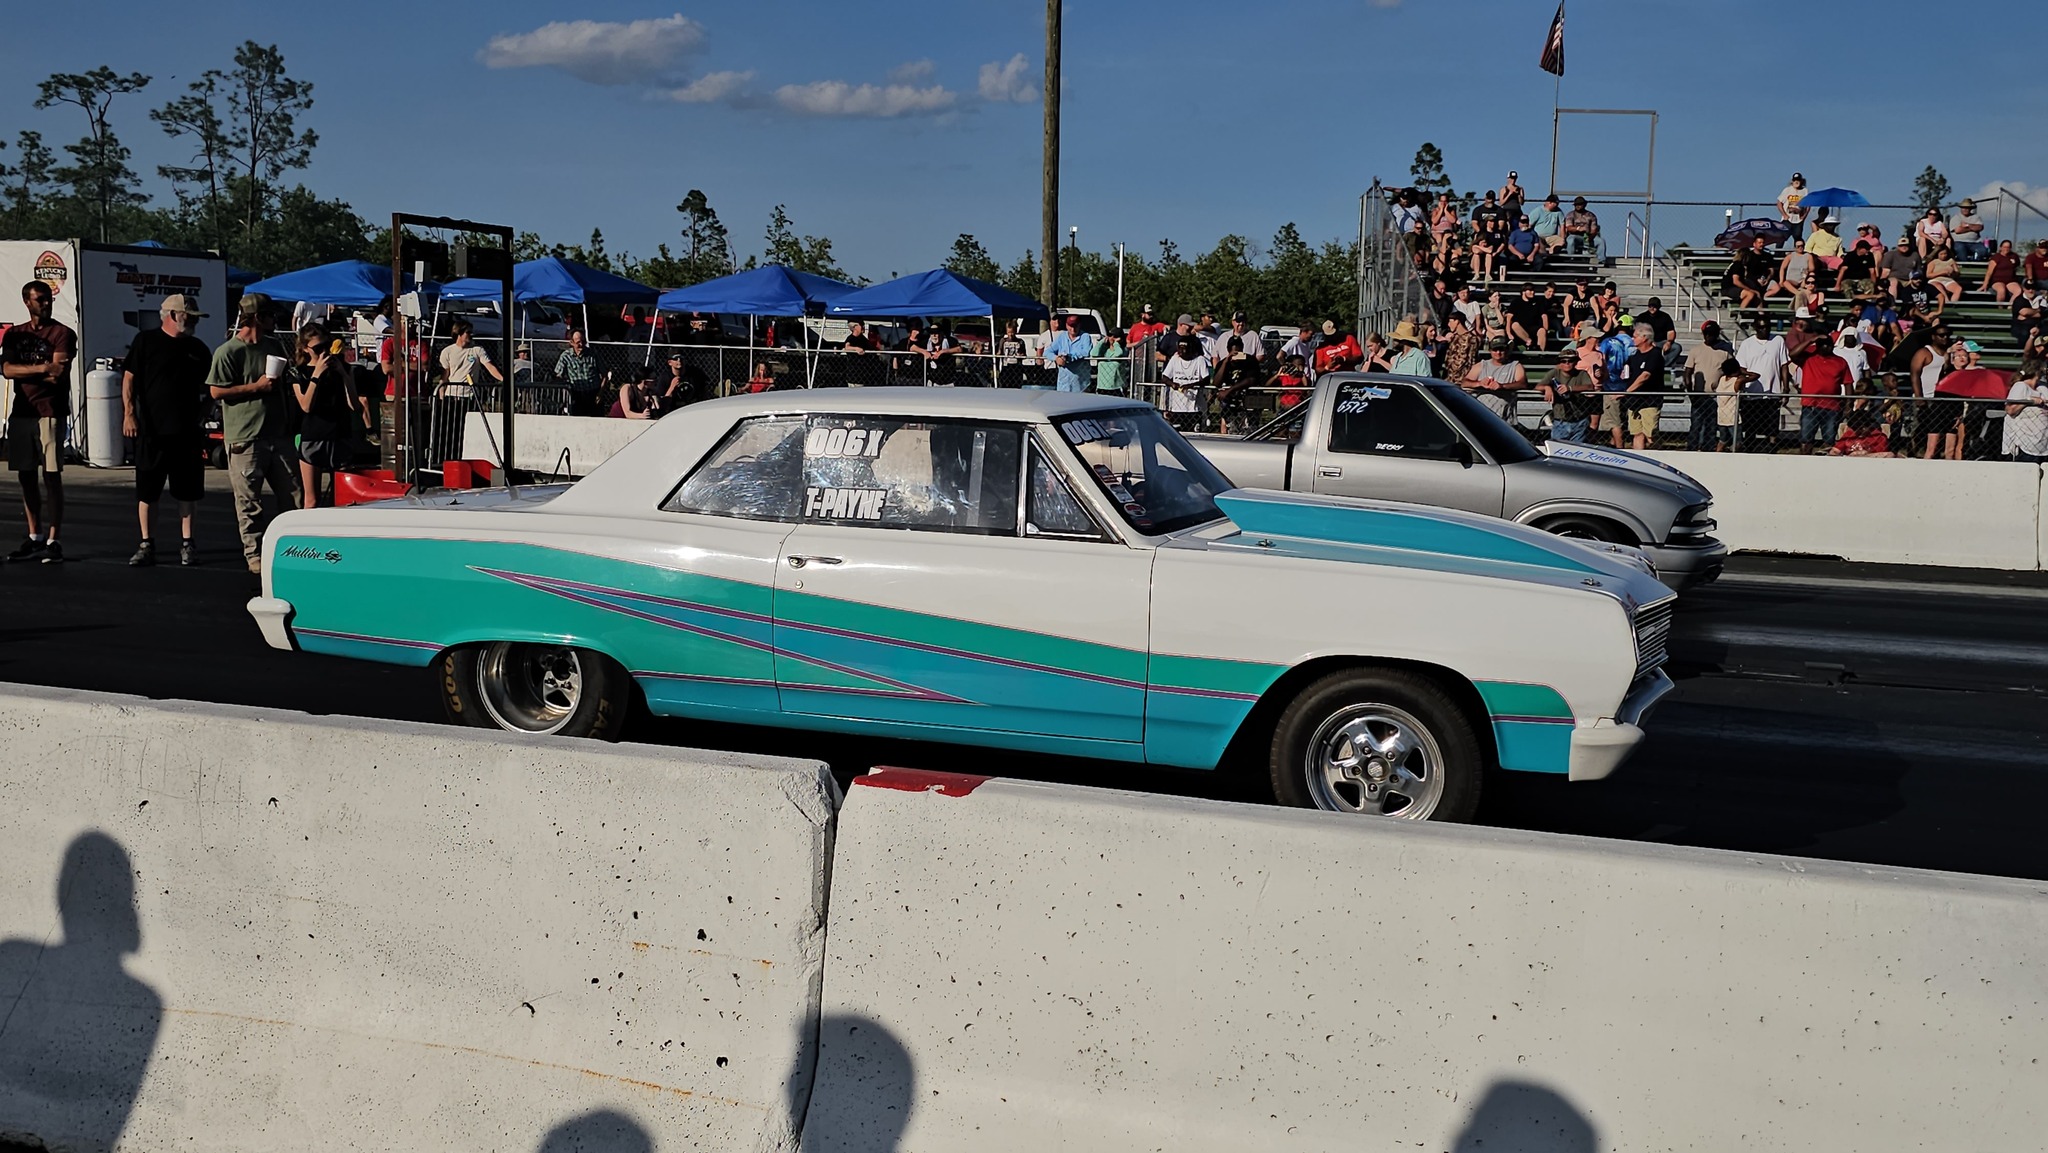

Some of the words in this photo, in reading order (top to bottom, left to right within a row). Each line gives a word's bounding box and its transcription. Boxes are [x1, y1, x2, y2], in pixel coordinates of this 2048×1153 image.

[1337, 400, 1369, 414] 6572
[804, 427, 884, 457] 006X
[1061, 419, 1111, 445] 006X
[804, 487, 887, 520] T-PAYNE
[280, 545, 322, 560] Malibu
